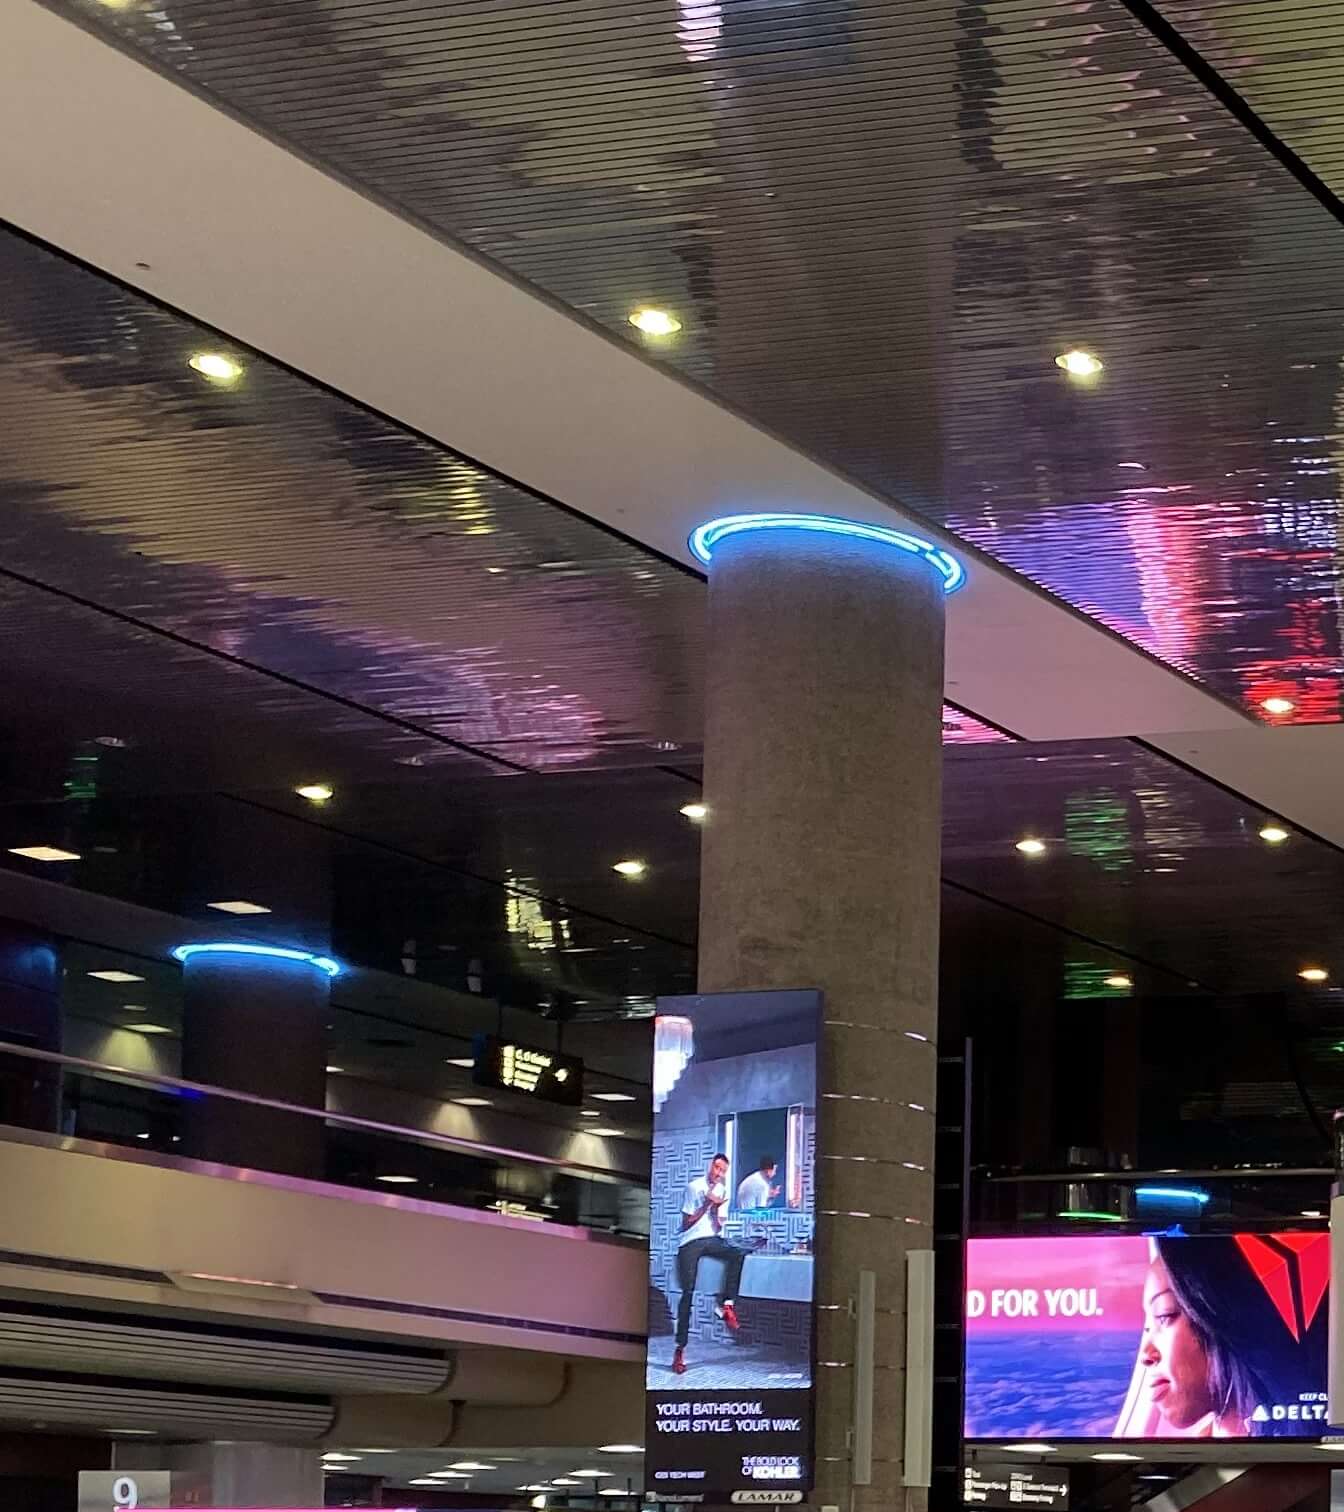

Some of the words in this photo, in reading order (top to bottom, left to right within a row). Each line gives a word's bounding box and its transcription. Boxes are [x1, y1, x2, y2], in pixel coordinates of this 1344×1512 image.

[991, 1288, 1039, 1318] FOR
[1044, 1287, 1104, 1317] YOU.
[656, 1403, 690, 1416] YOUR
[692, 1402, 763, 1416] BATHROOM.
[656, 1420, 690, 1432] YOUR
[692, 1419, 733, 1432] STYLE.
[735, 1419, 771, 1431] YOUR
[772, 1418, 801, 1431] WAY.
[113, 1477, 138, 1510] 9
[738, 1492, 795, 1501] LAMAR
